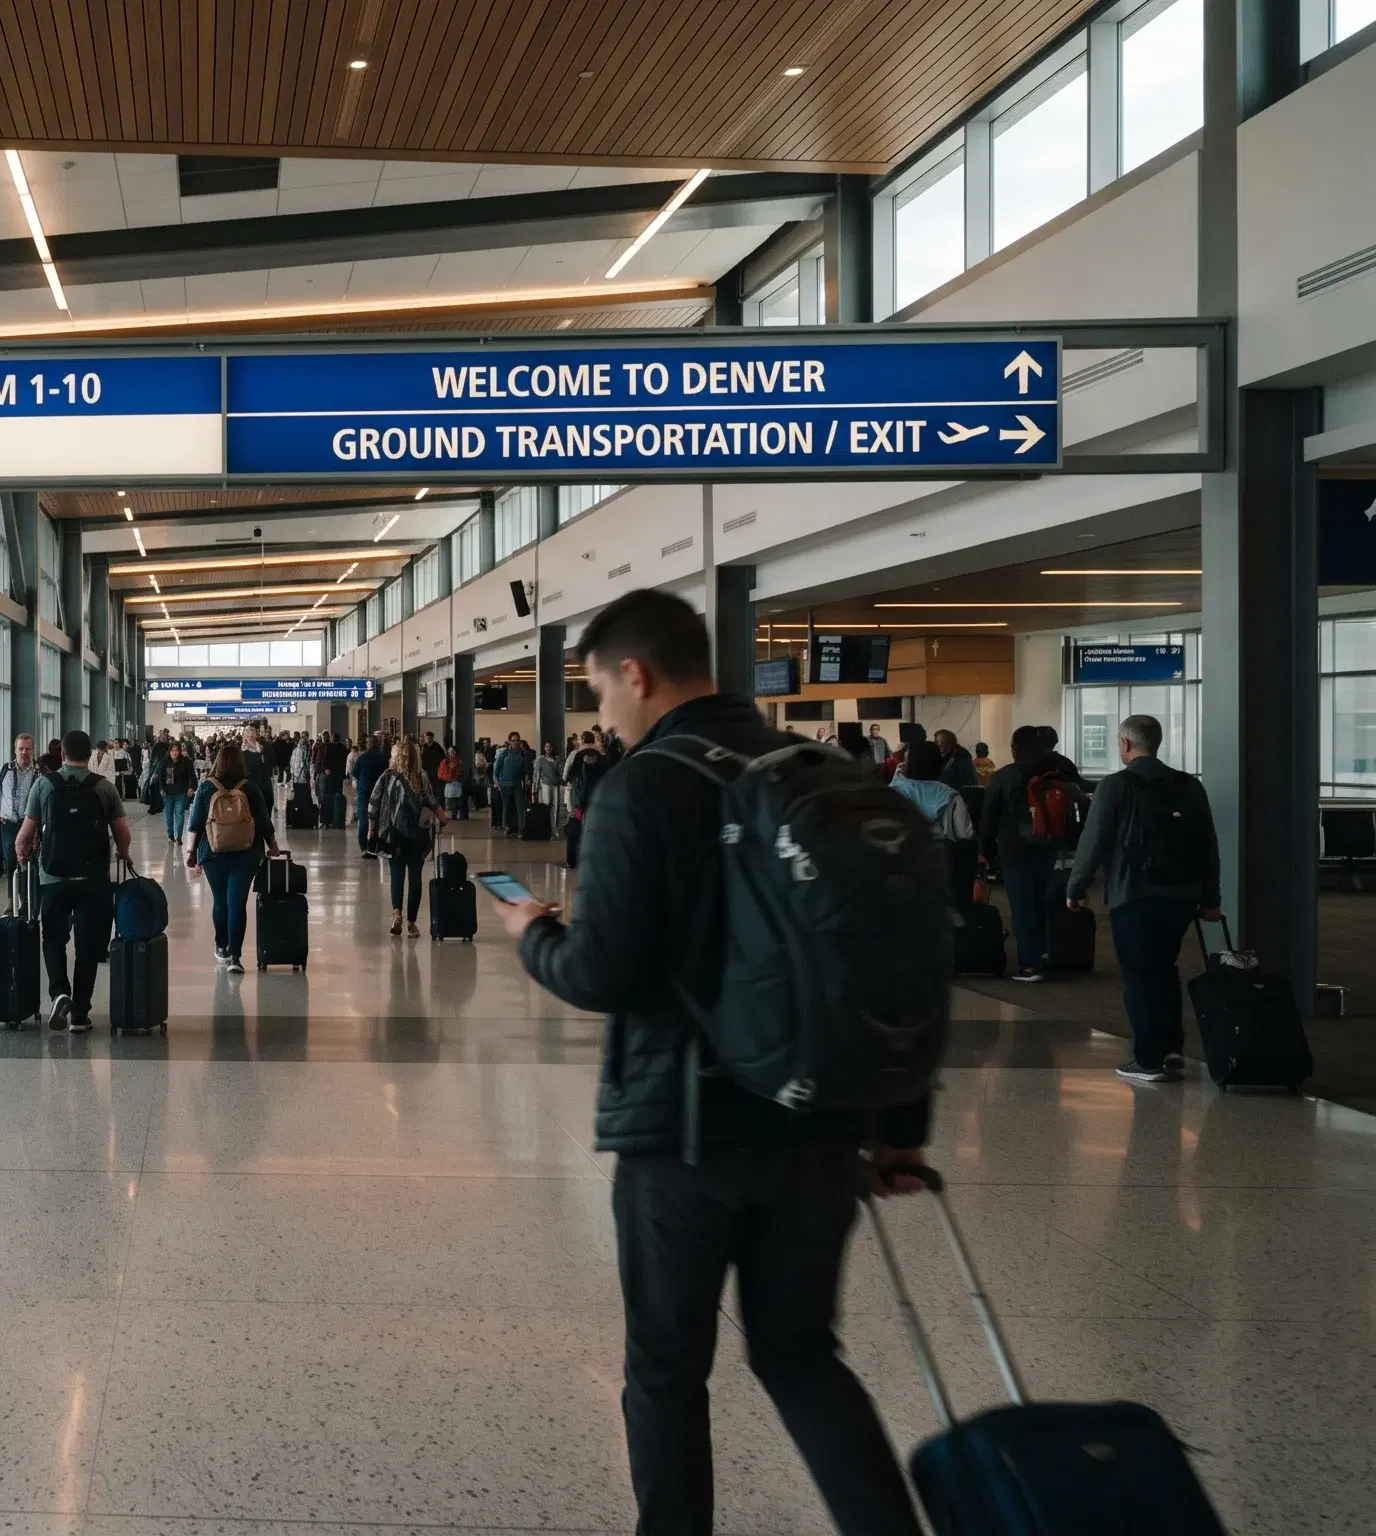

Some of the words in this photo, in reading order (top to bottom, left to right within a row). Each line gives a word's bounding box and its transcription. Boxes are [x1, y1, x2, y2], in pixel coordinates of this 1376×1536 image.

[30, 372, 102, 405] 1-10
[432, 363, 612, 399] WELCOME
[622, 362, 669, 396] TO
[682, 360, 826, 395] DENVER
[332, 426, 486, 461] GROUND
[495, 421, 813, 458] TRANSPORTATION
[825, 420, 839, 455] /
[850, 420, 927, 454] EXIT
